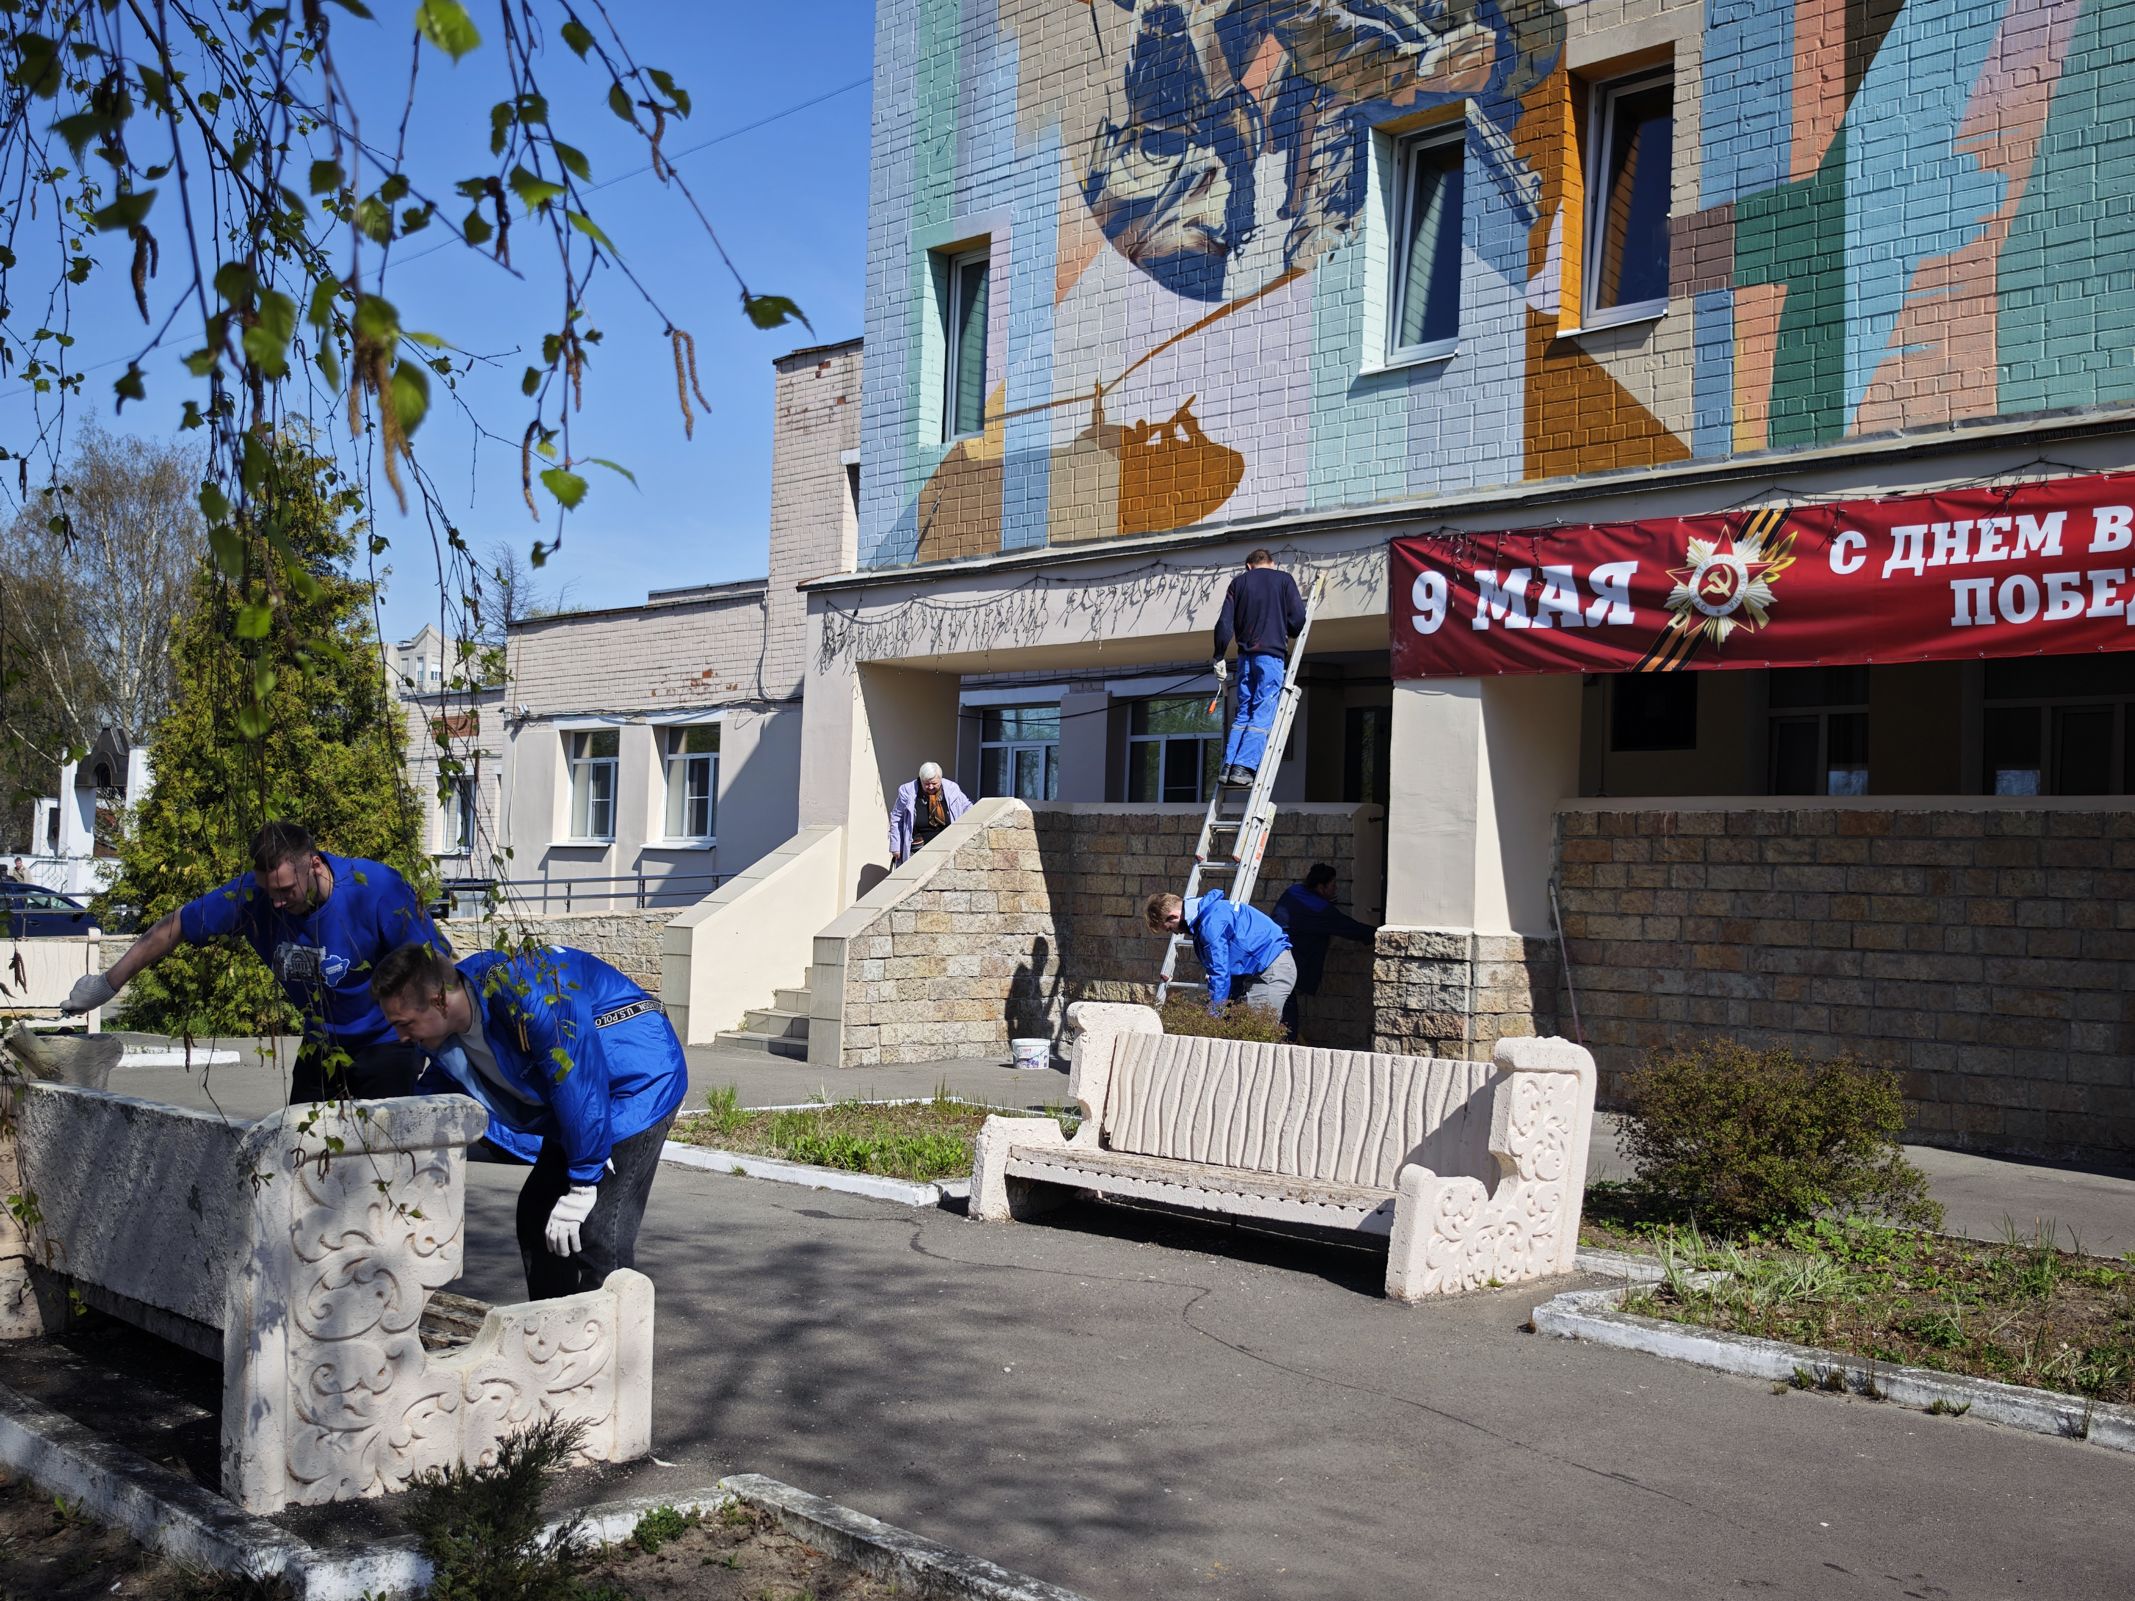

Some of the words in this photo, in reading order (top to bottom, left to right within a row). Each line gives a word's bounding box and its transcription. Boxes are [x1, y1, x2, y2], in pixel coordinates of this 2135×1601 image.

[1829, 530, 1867, 575] С
[1882, 511, 2067, 579] ДНЕМ
[2088, 505, 2135, 553] В
[1412, 570, 1447, 635] 9
[1472, 560, 1638, 631] МАЯ
[1951, 568, 2135, 626] ПОБЕ
